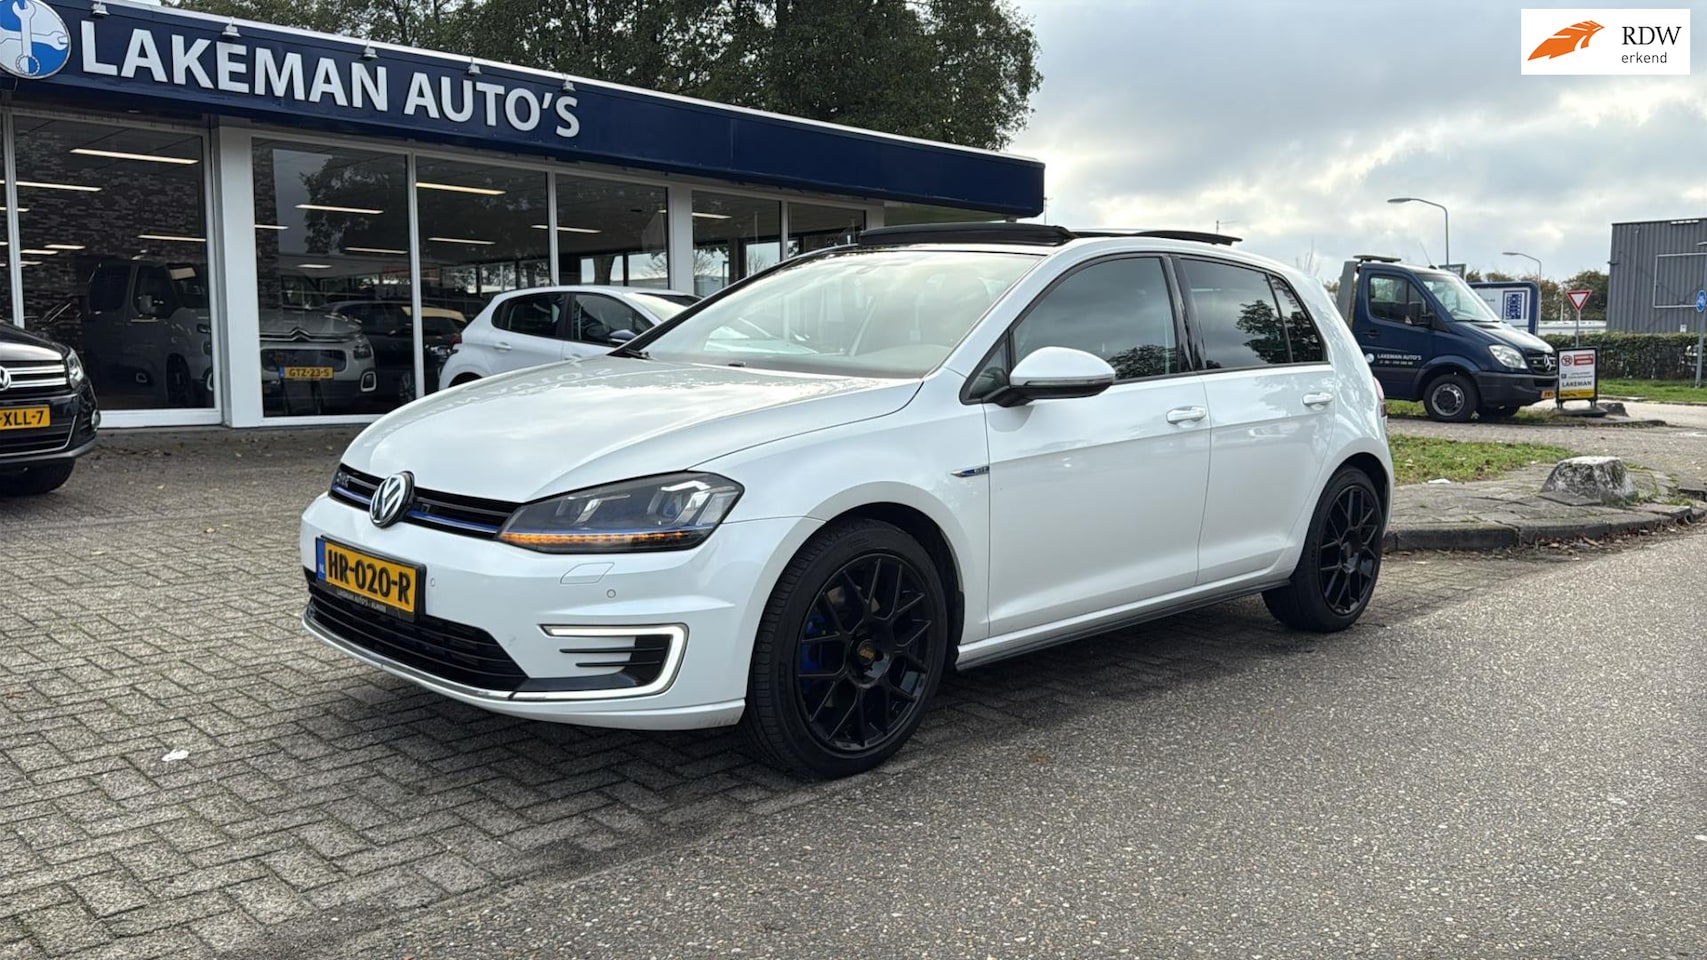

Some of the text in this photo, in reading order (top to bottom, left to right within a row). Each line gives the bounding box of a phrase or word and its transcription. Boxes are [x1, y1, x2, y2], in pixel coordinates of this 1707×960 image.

[81, 20, 581, 138] LAKEMAN AUTO'S
[1561, 380, 1592, 388] LAKEMAN
[327, 548, 411, 606] HR-020-R
